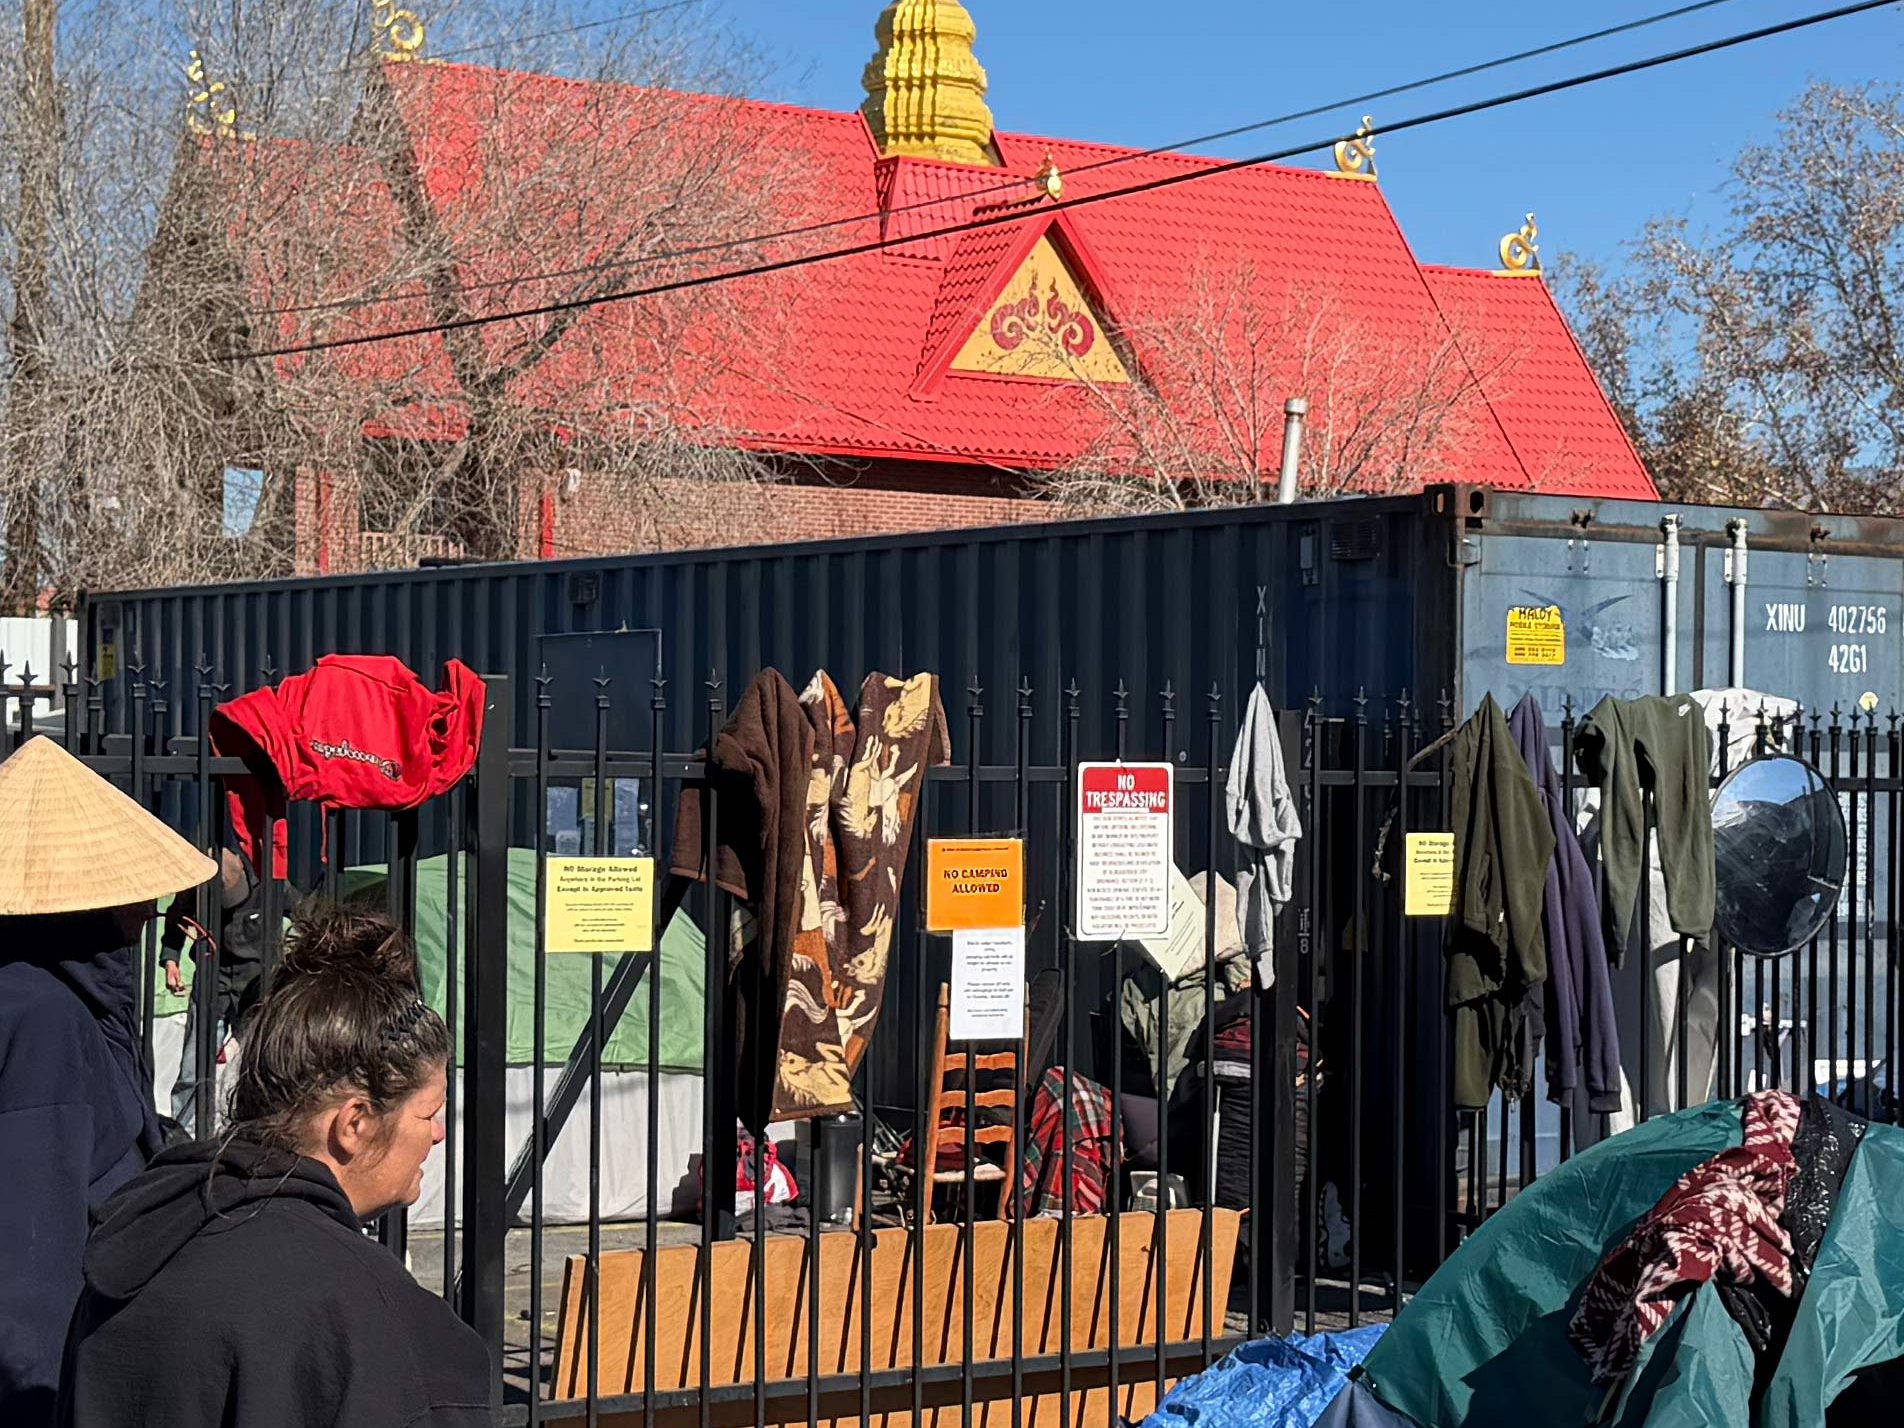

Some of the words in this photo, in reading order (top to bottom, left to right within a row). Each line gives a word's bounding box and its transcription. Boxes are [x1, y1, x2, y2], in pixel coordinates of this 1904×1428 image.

[1765, 603, 1806, 632] XINU
[1828, 605, 1887, 634] 402756
[1828, 644, 1867, 673] 42G1
[1117, 774, 1135, 791] NO
[1086, 791, 1166, 808] TRESPASSING
[943, 870, 959, 879] NO
[961, 869, 1008, 878] CAMPING
[952, 884, 1000, 893] ALLOWED
